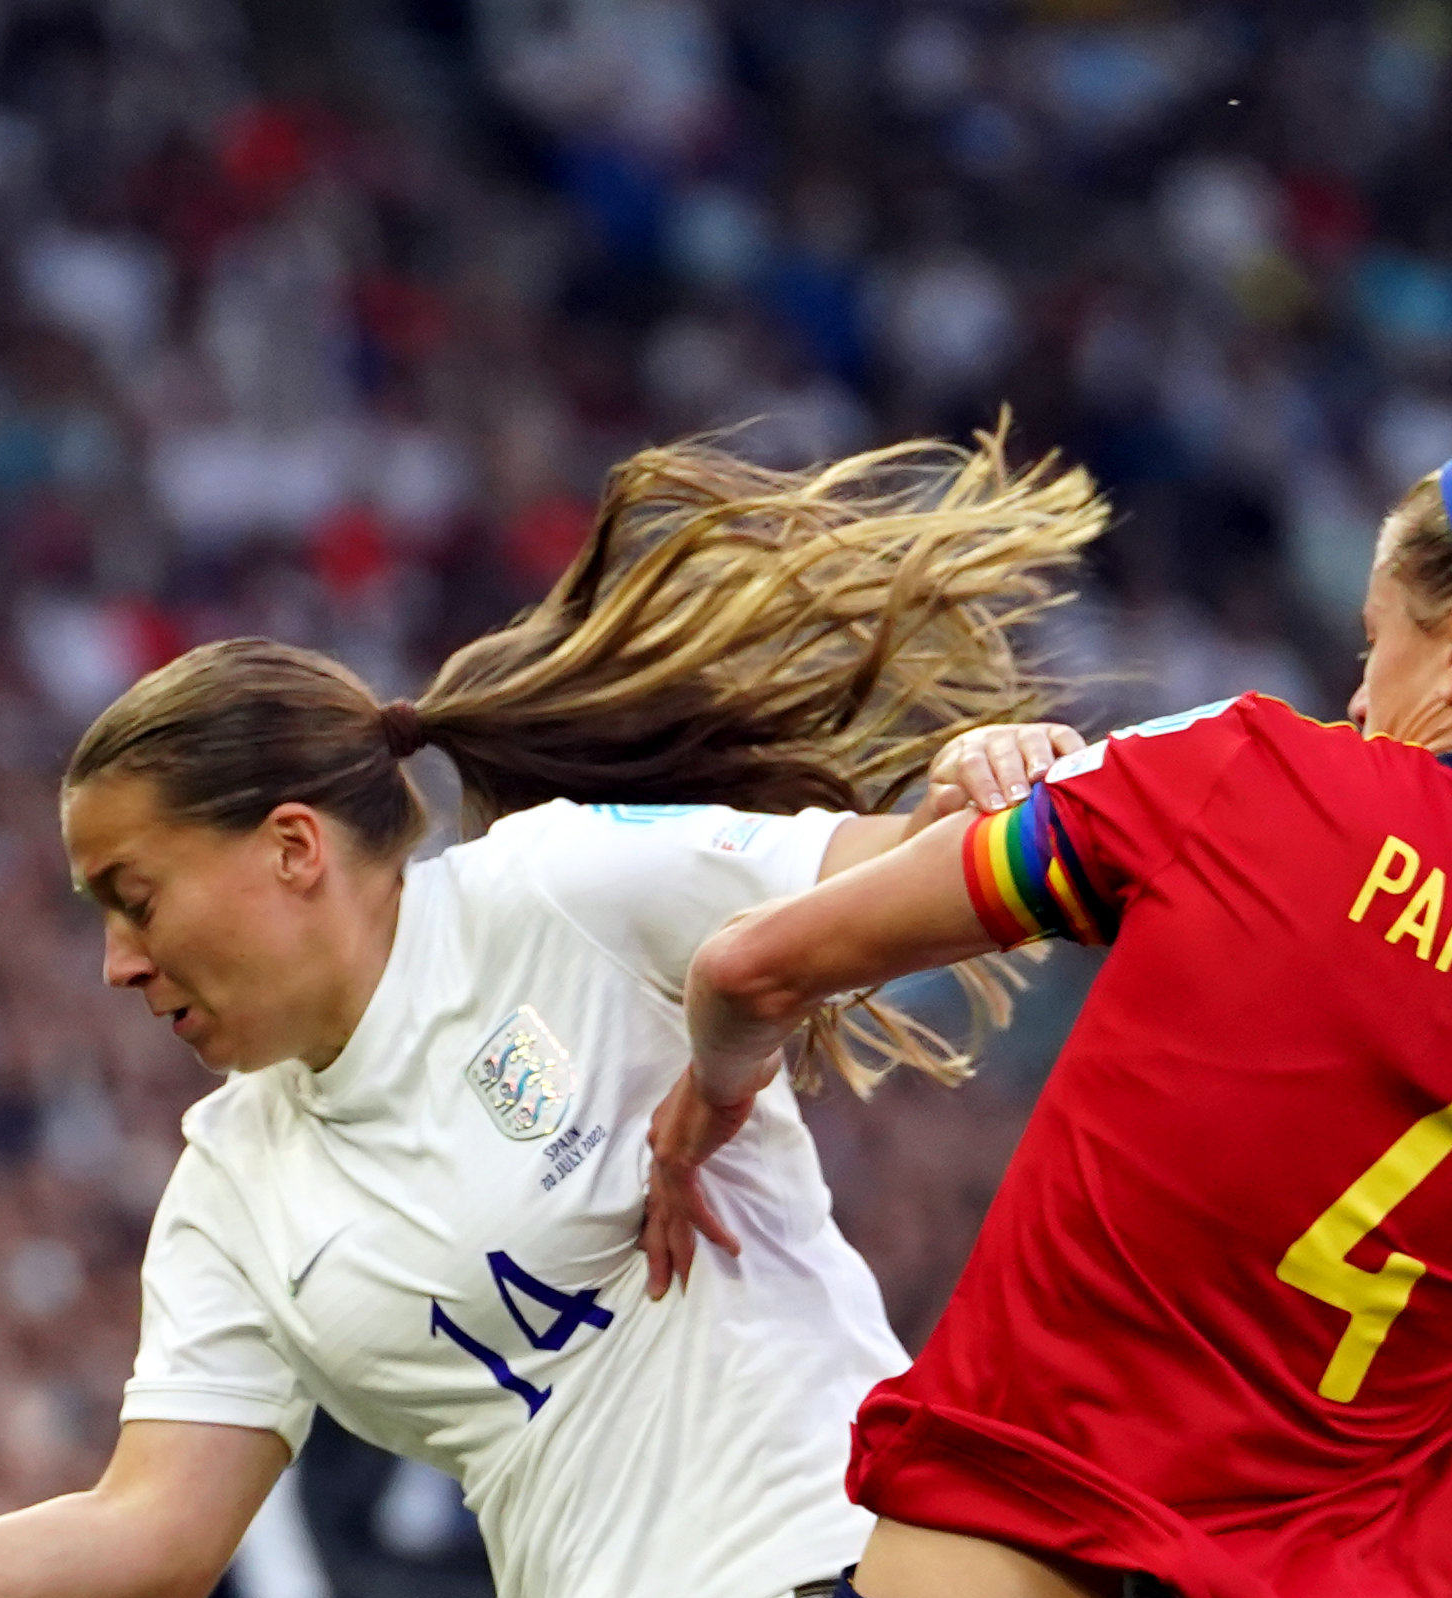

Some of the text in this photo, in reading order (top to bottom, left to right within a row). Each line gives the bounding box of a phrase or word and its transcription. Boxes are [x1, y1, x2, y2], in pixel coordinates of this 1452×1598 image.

[542, 1126, 581, 1162] SPAIN
[555, 1146, 585, 1180] JULY
[431, 1251, 614, 1422] 14
